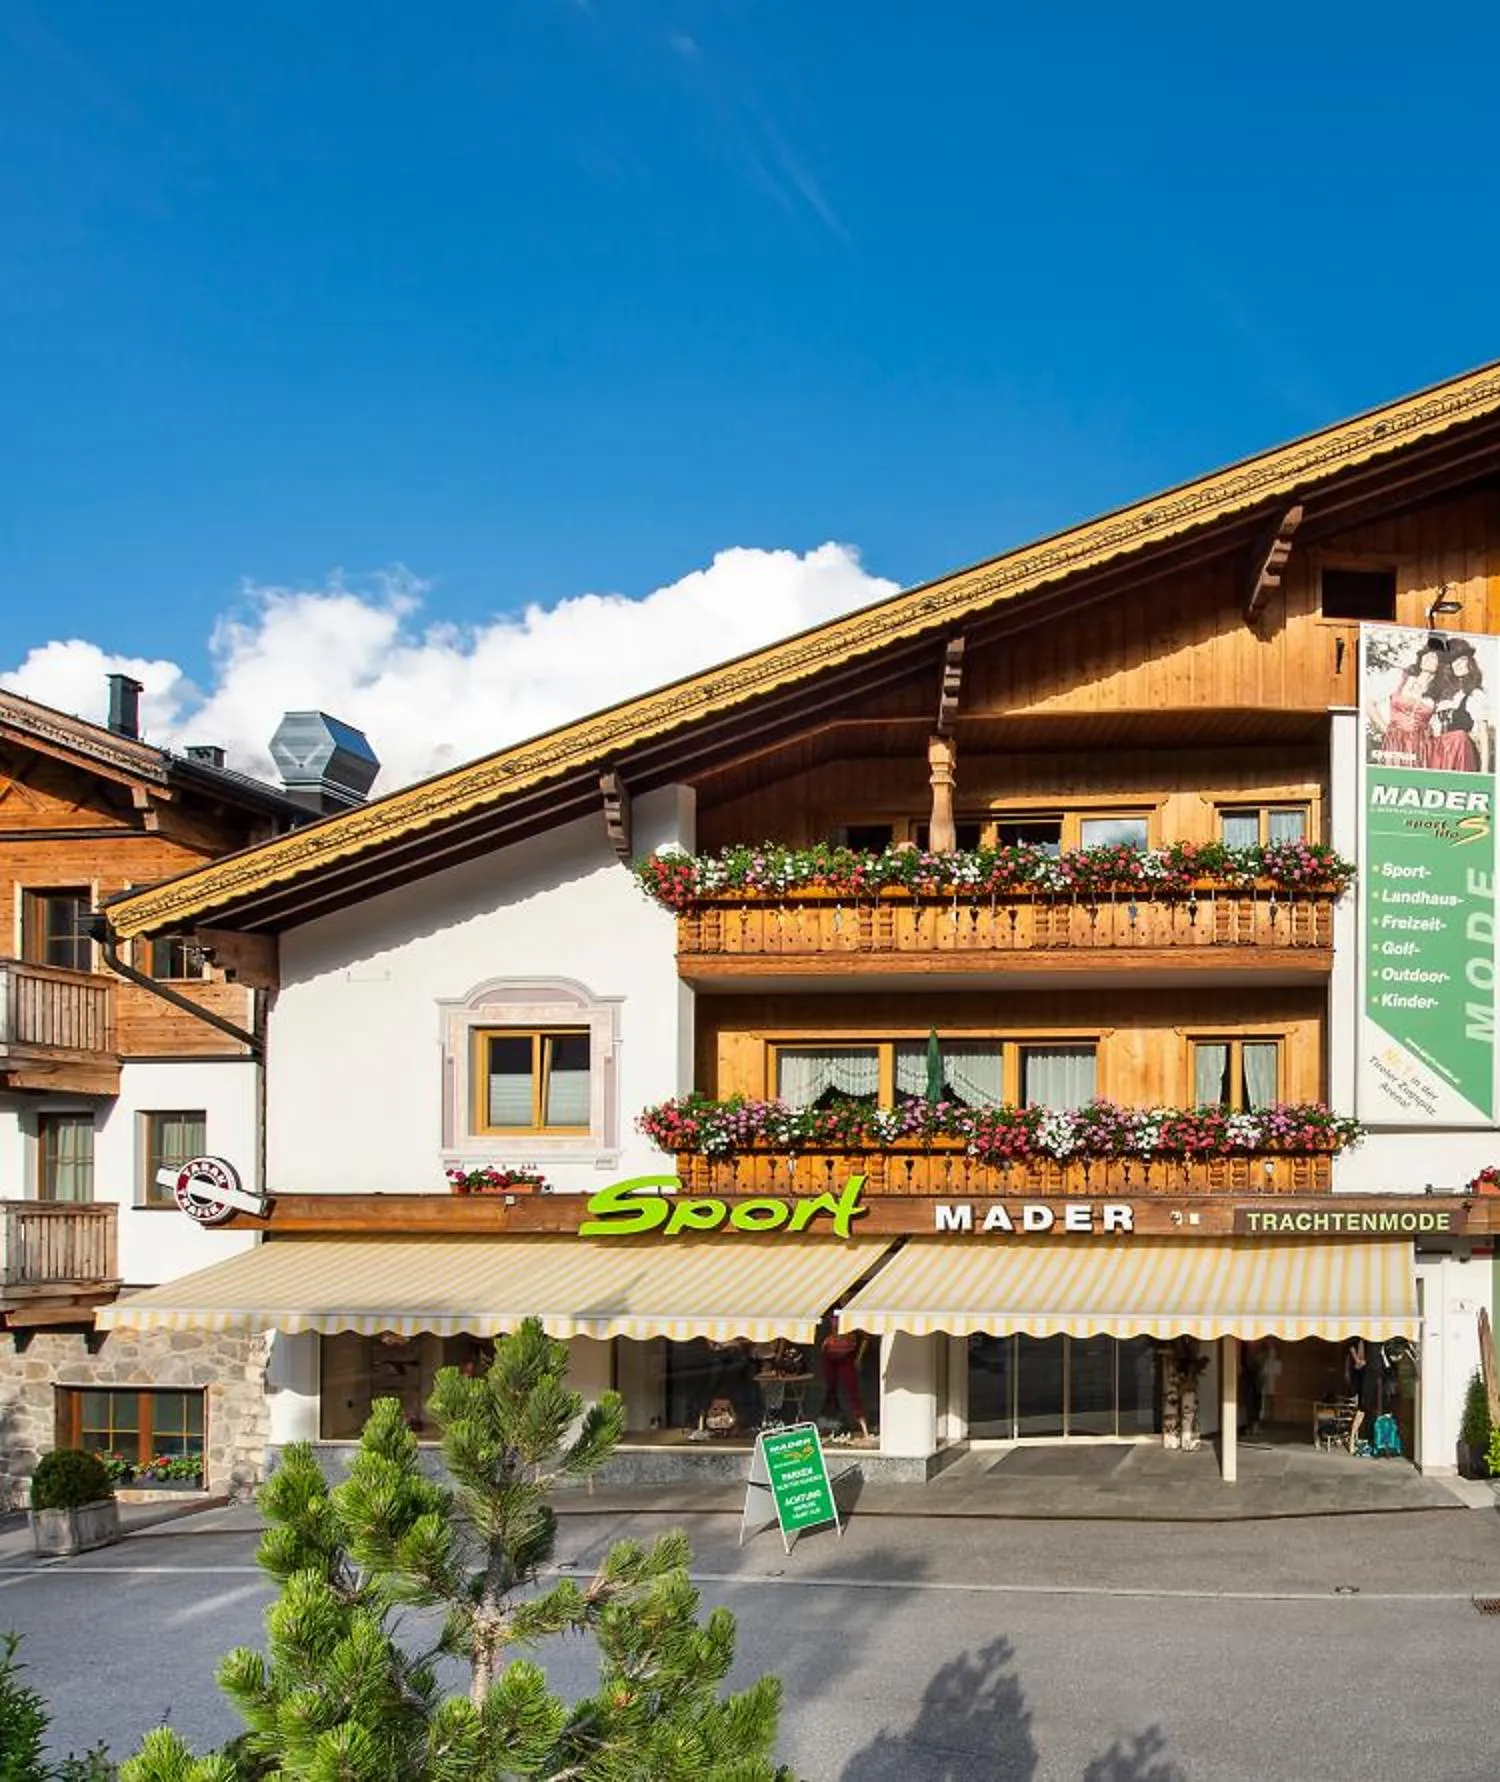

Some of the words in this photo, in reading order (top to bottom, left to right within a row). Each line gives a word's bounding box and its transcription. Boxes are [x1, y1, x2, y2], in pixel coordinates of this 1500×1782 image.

[1371, 785, 1490, 812] MADER
[1381, 863, 1433, 879] Sport-
[1382, 890, 1465, 906] Landhaus-
[1381, 915, 1448, 931] Freizeit-
[1381, 941, 1421, 956] Golf-
[1465, 867, 1494, 1044] MODE
[1381, 967, 1451, 983] Outdoor-
[1381, 993, 1440, 1009] Kinder-
[578, 1175, 868, 1239] Sport
[934, 1204, 1136, 1232] MADER
[1246, 1211, 1452, 1232] TRACHTENMODE
